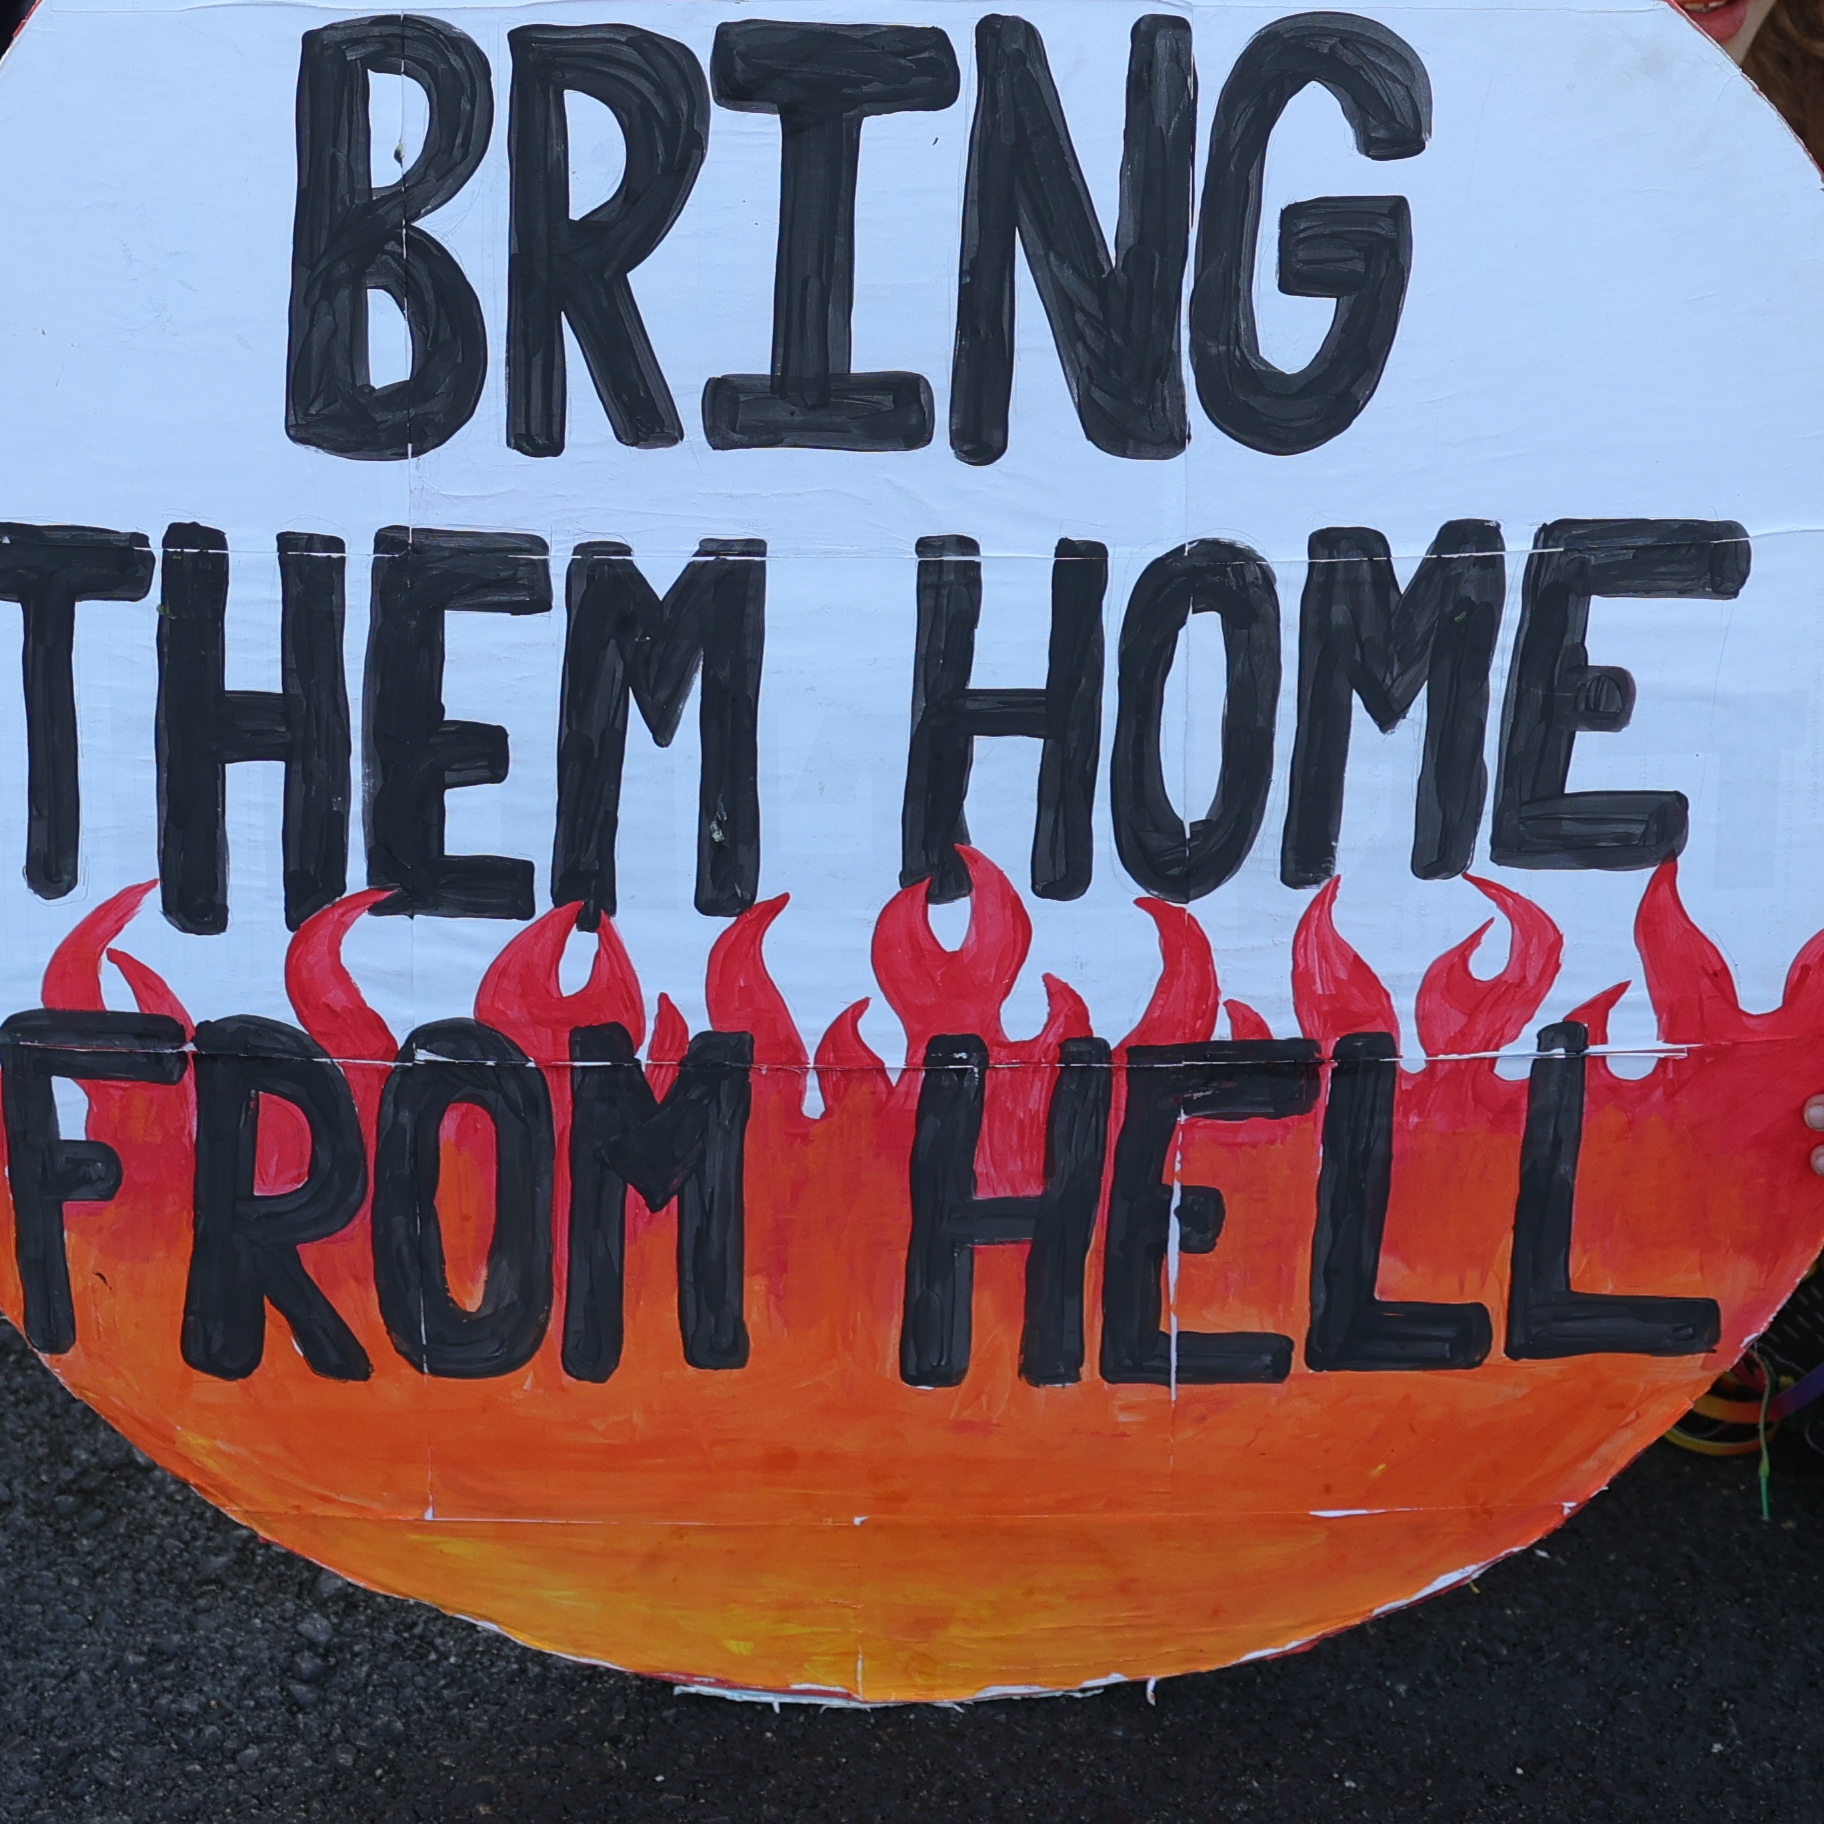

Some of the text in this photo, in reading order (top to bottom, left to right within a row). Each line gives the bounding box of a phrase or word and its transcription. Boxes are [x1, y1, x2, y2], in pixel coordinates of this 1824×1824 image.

[285, 13, 1432, 467] BRING
[899, 518, 1752, 905] HOME
[898, 1018, 1722, 1389] HELL
